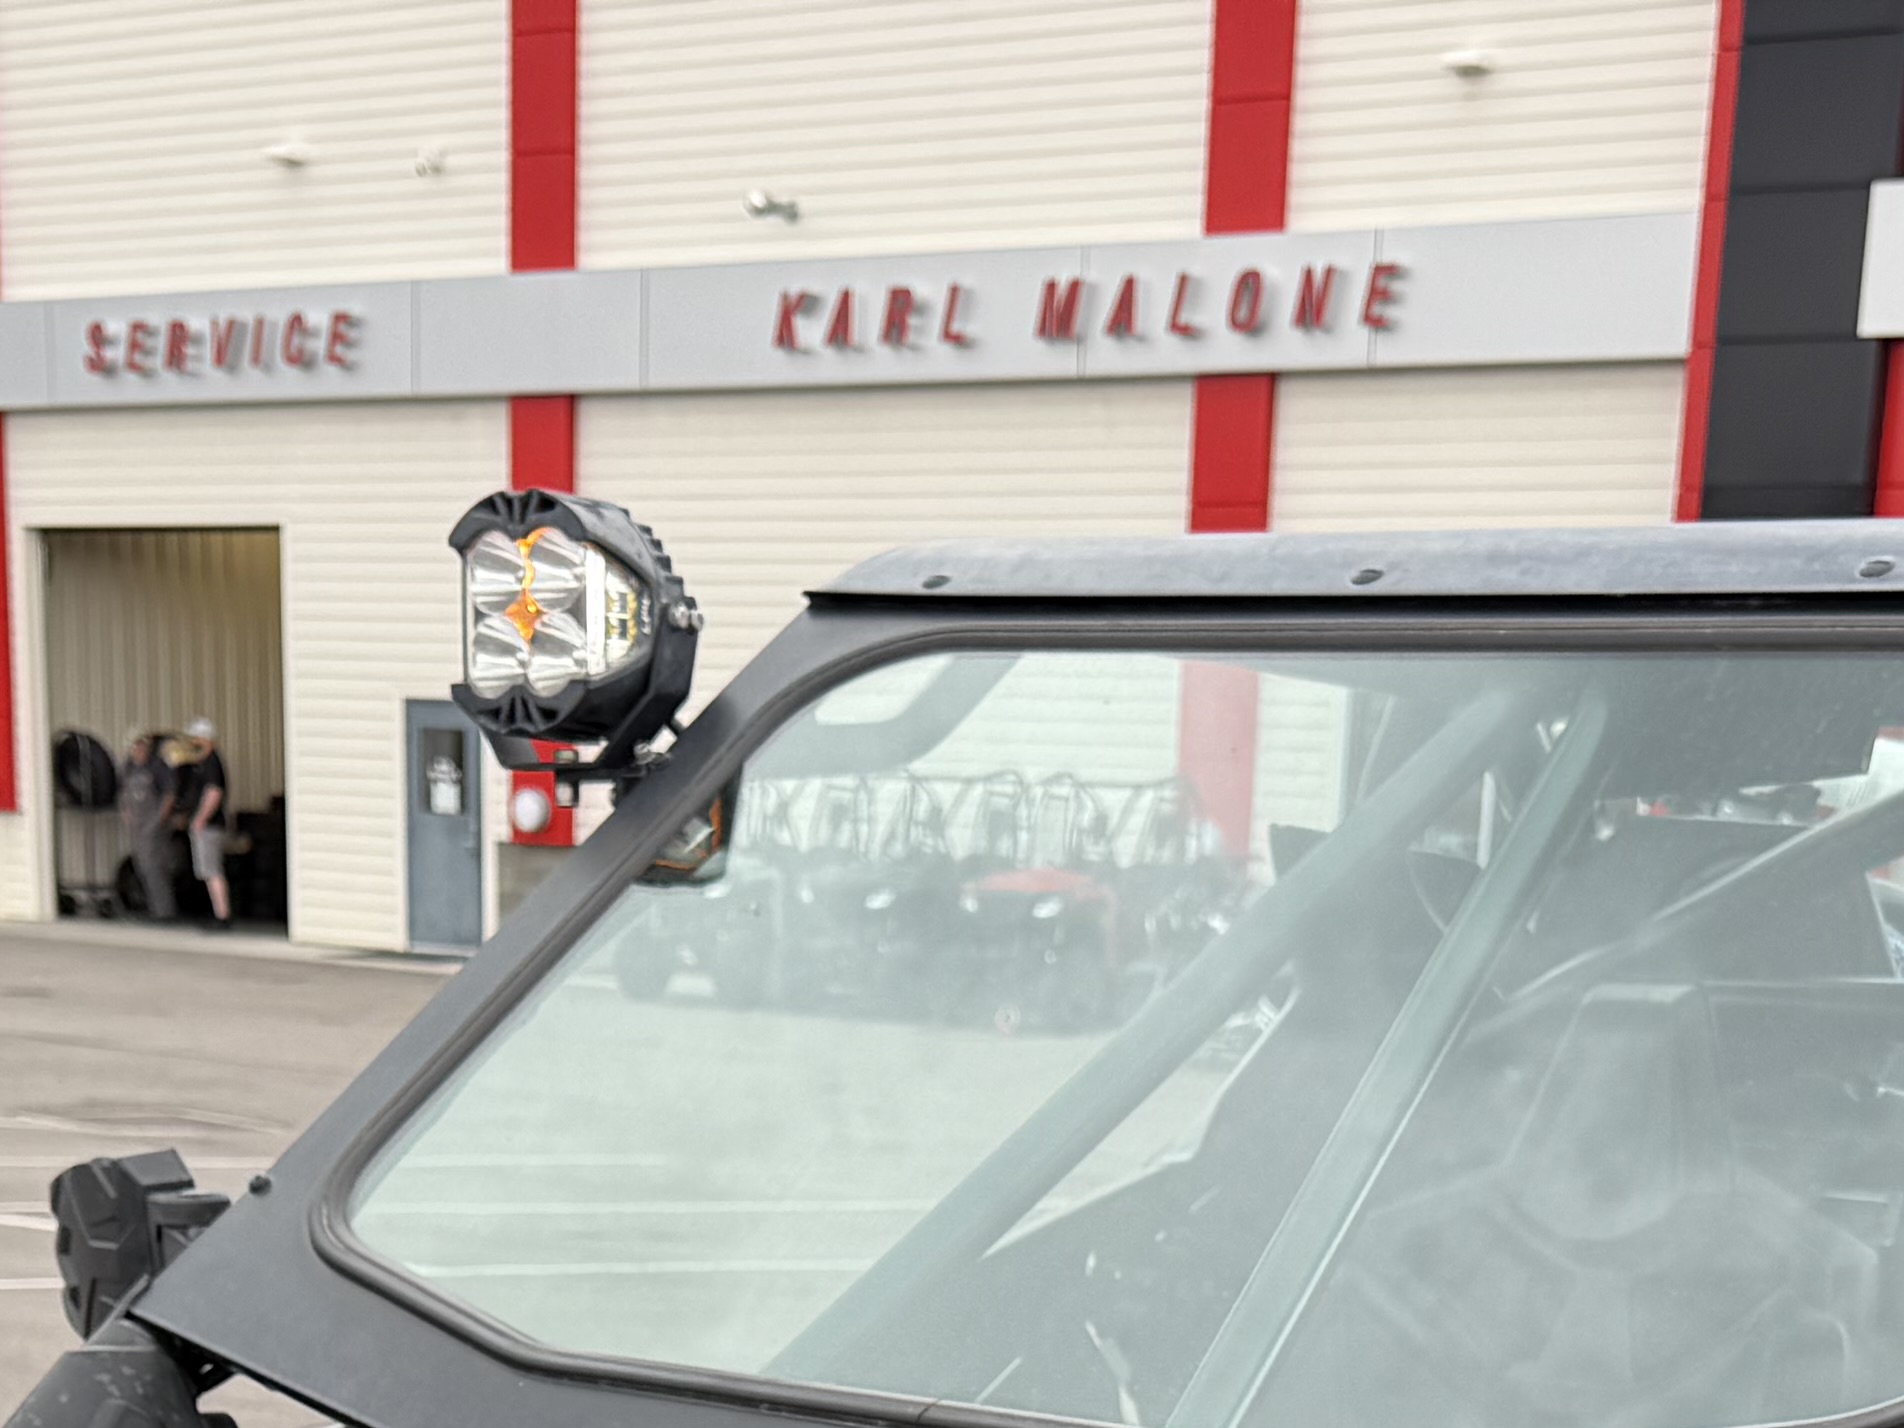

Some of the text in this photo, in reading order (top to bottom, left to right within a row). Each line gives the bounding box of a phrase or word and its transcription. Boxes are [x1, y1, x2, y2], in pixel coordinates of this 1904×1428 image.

[81, 310, 354, 374] SERVICE
[771, 262, 1401, 350] KARL MALONE
